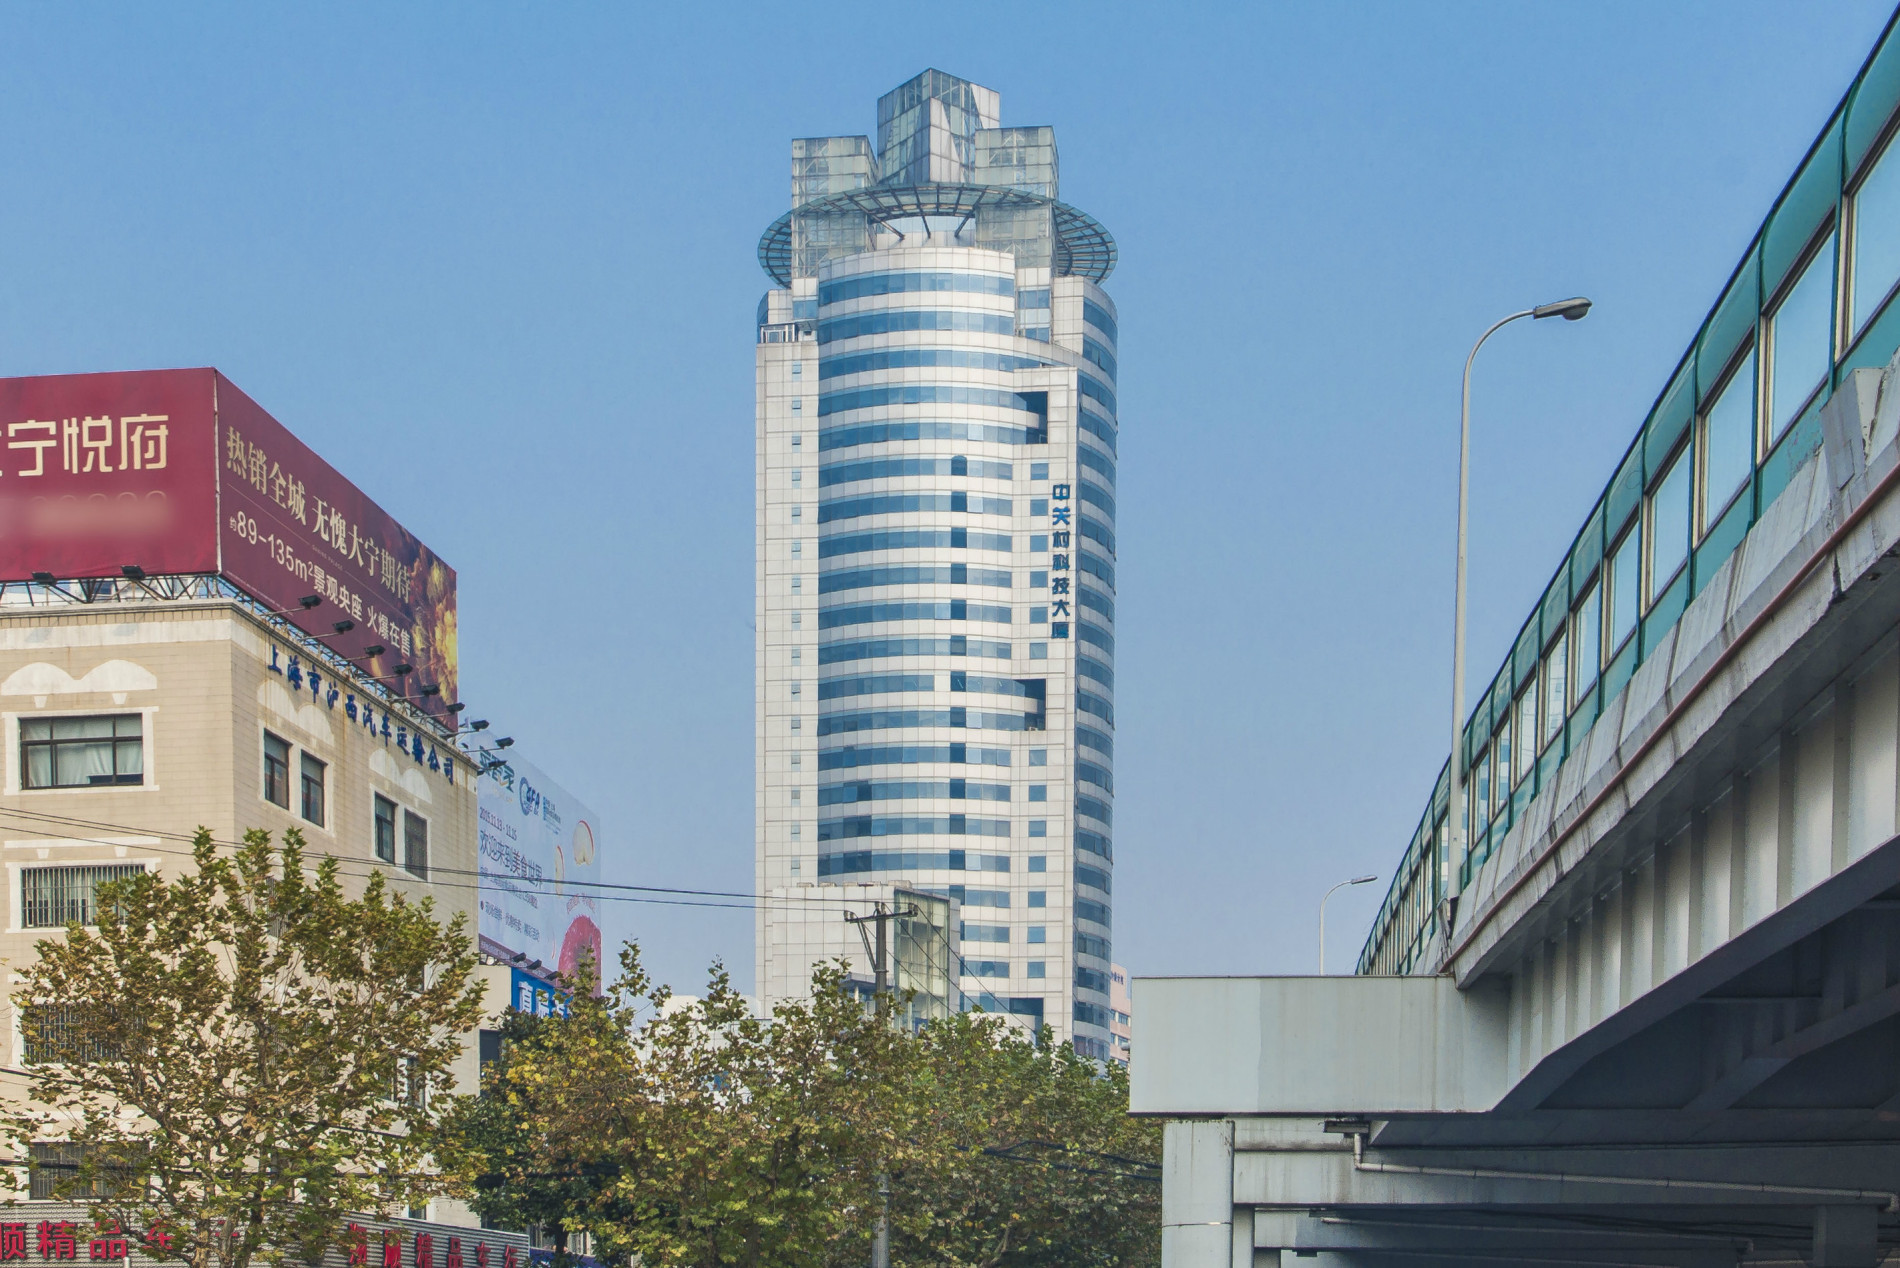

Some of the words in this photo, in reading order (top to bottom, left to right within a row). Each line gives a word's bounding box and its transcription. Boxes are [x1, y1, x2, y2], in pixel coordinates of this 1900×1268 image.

[0, 413, 169, 476] 宁悦府
[226, 426, 306, 526] 热销全城
[312, 495, 411, 604] 无愧大宁期待
[1051, 484, 1070, 639] 中关村科技大厦
[367, 605, 410, 656] 火爆在售
[268, 643, 454, 785] 上海市沪西汽车运输公司
[480, 830, 543, 888] 欢迎来到美食世界
